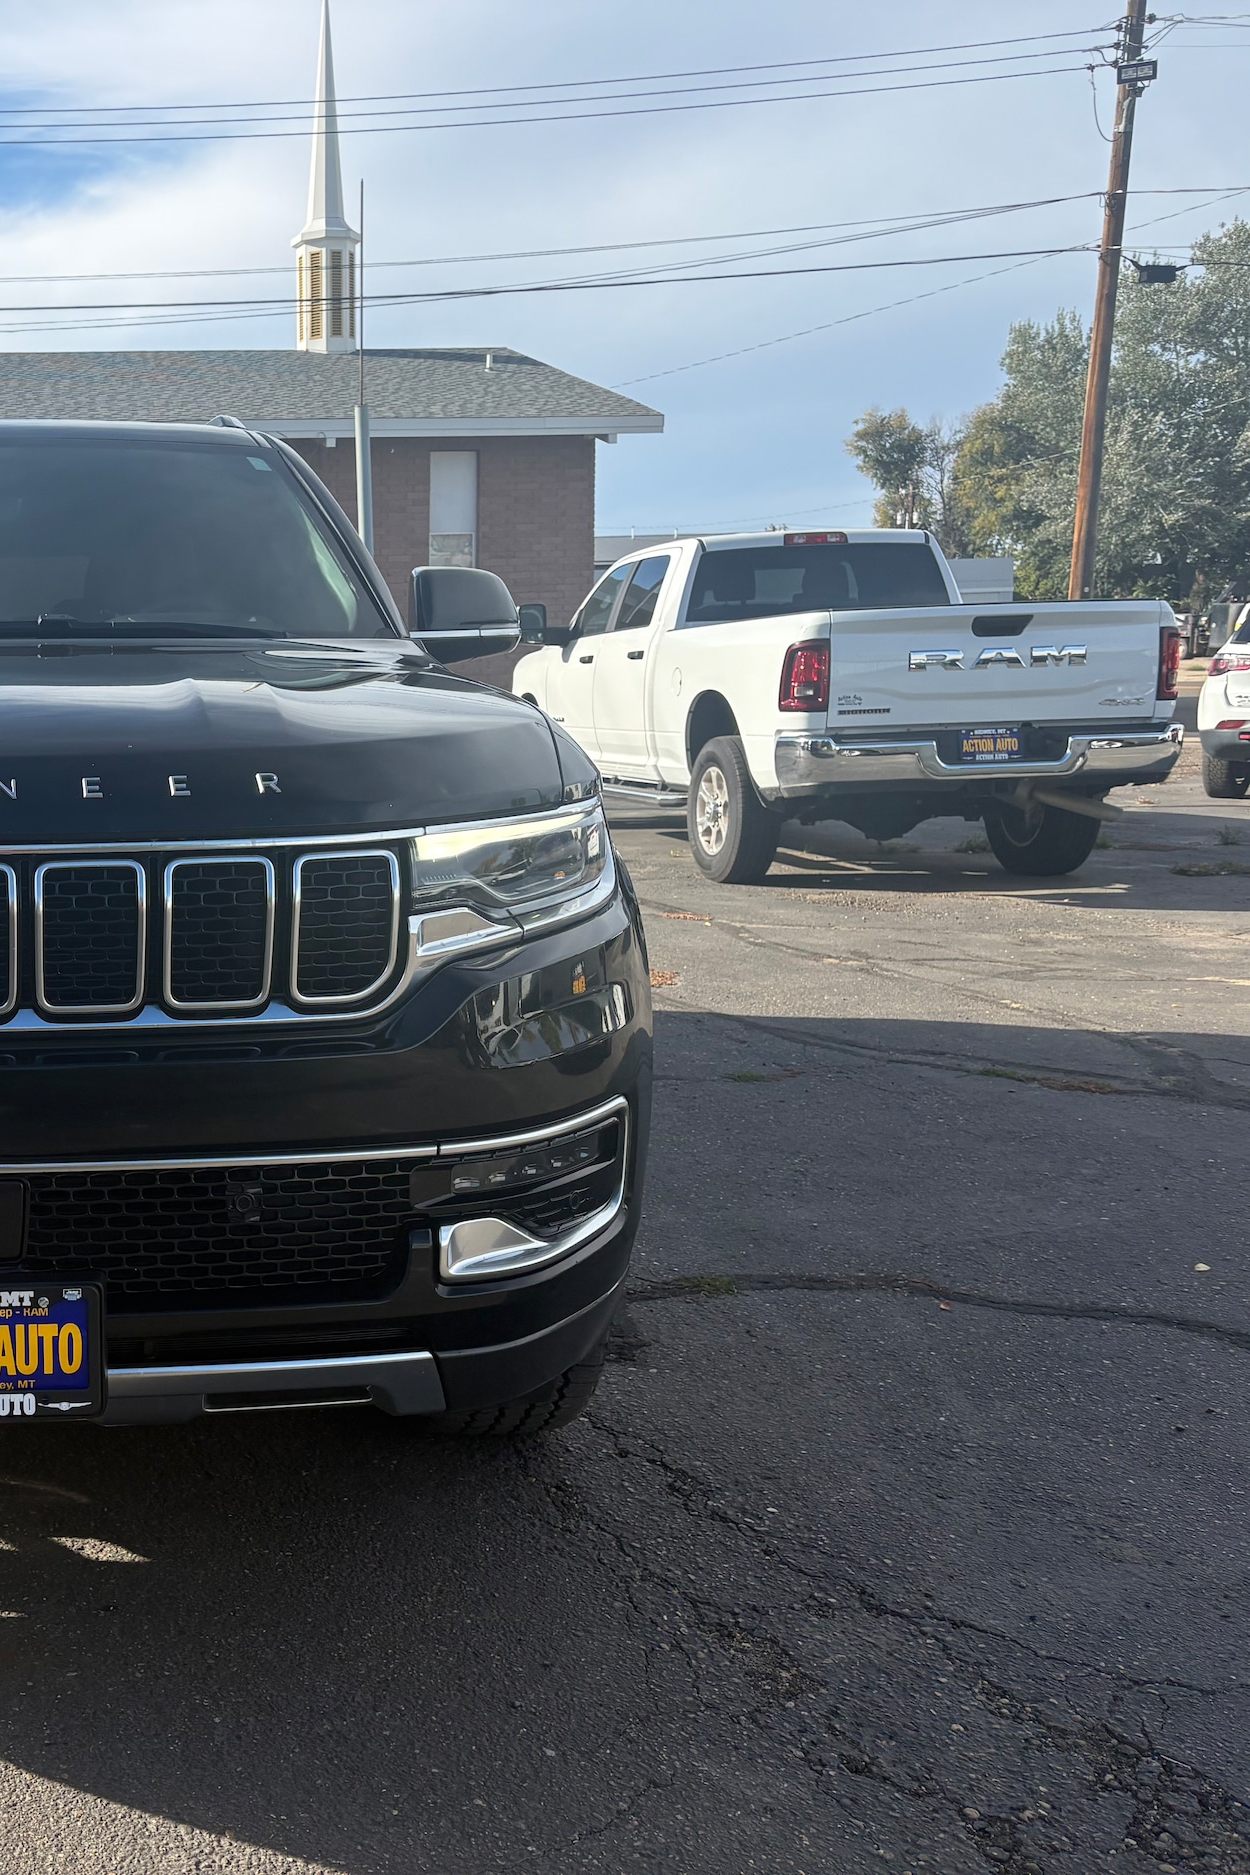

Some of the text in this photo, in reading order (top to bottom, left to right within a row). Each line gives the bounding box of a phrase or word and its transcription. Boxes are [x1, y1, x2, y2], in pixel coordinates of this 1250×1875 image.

[908, 644, 1088, 672] RAM
[963, 737, 1018, 752] ACTION AUTO
[0, 1290, 35, 1308] MT
[23, 1307, 49, 1317] RAM
[17, 1379, 37, 1389] MT
